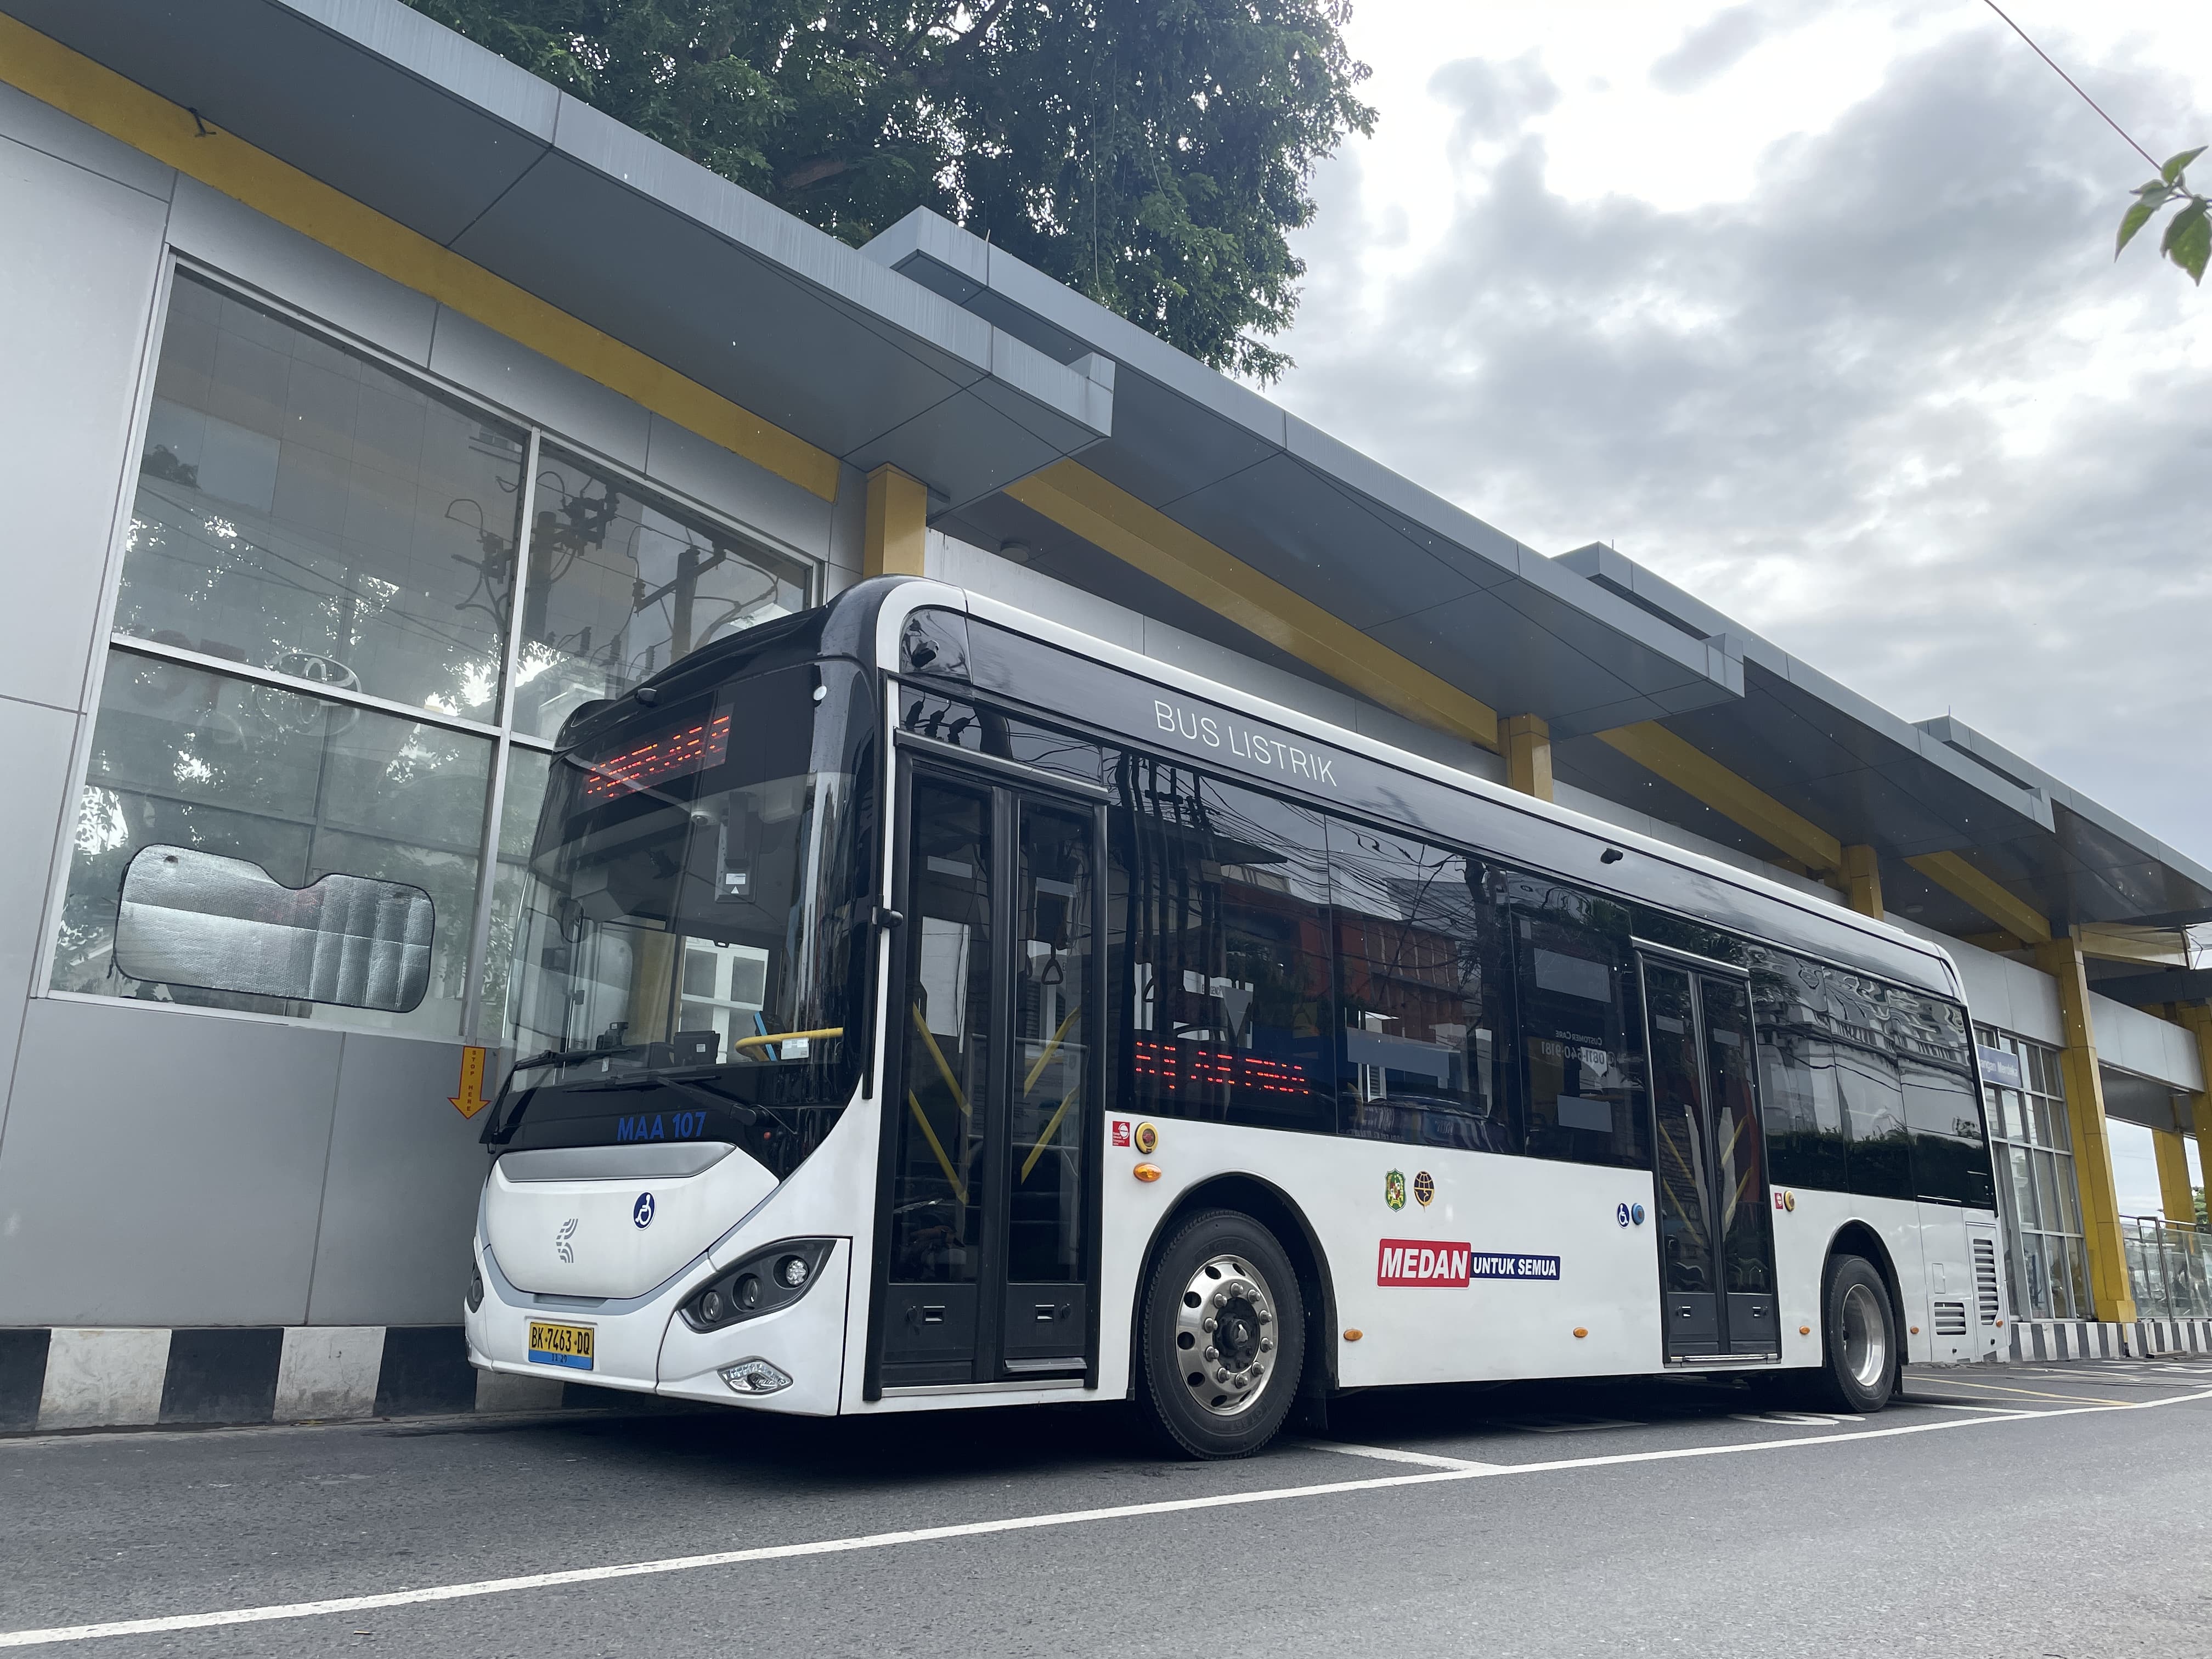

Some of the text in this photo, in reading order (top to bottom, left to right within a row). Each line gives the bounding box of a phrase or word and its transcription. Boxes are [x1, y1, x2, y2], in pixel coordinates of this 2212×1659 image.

[1154, 700, 1337, 787] BUS LISTRIK
[617, 1111, 707, 1142] MAA 107
[1380, 1248, 1557, 1279] MEDAN UNTUK SEMUA
[548, 1328, 572, 1352] 7463
